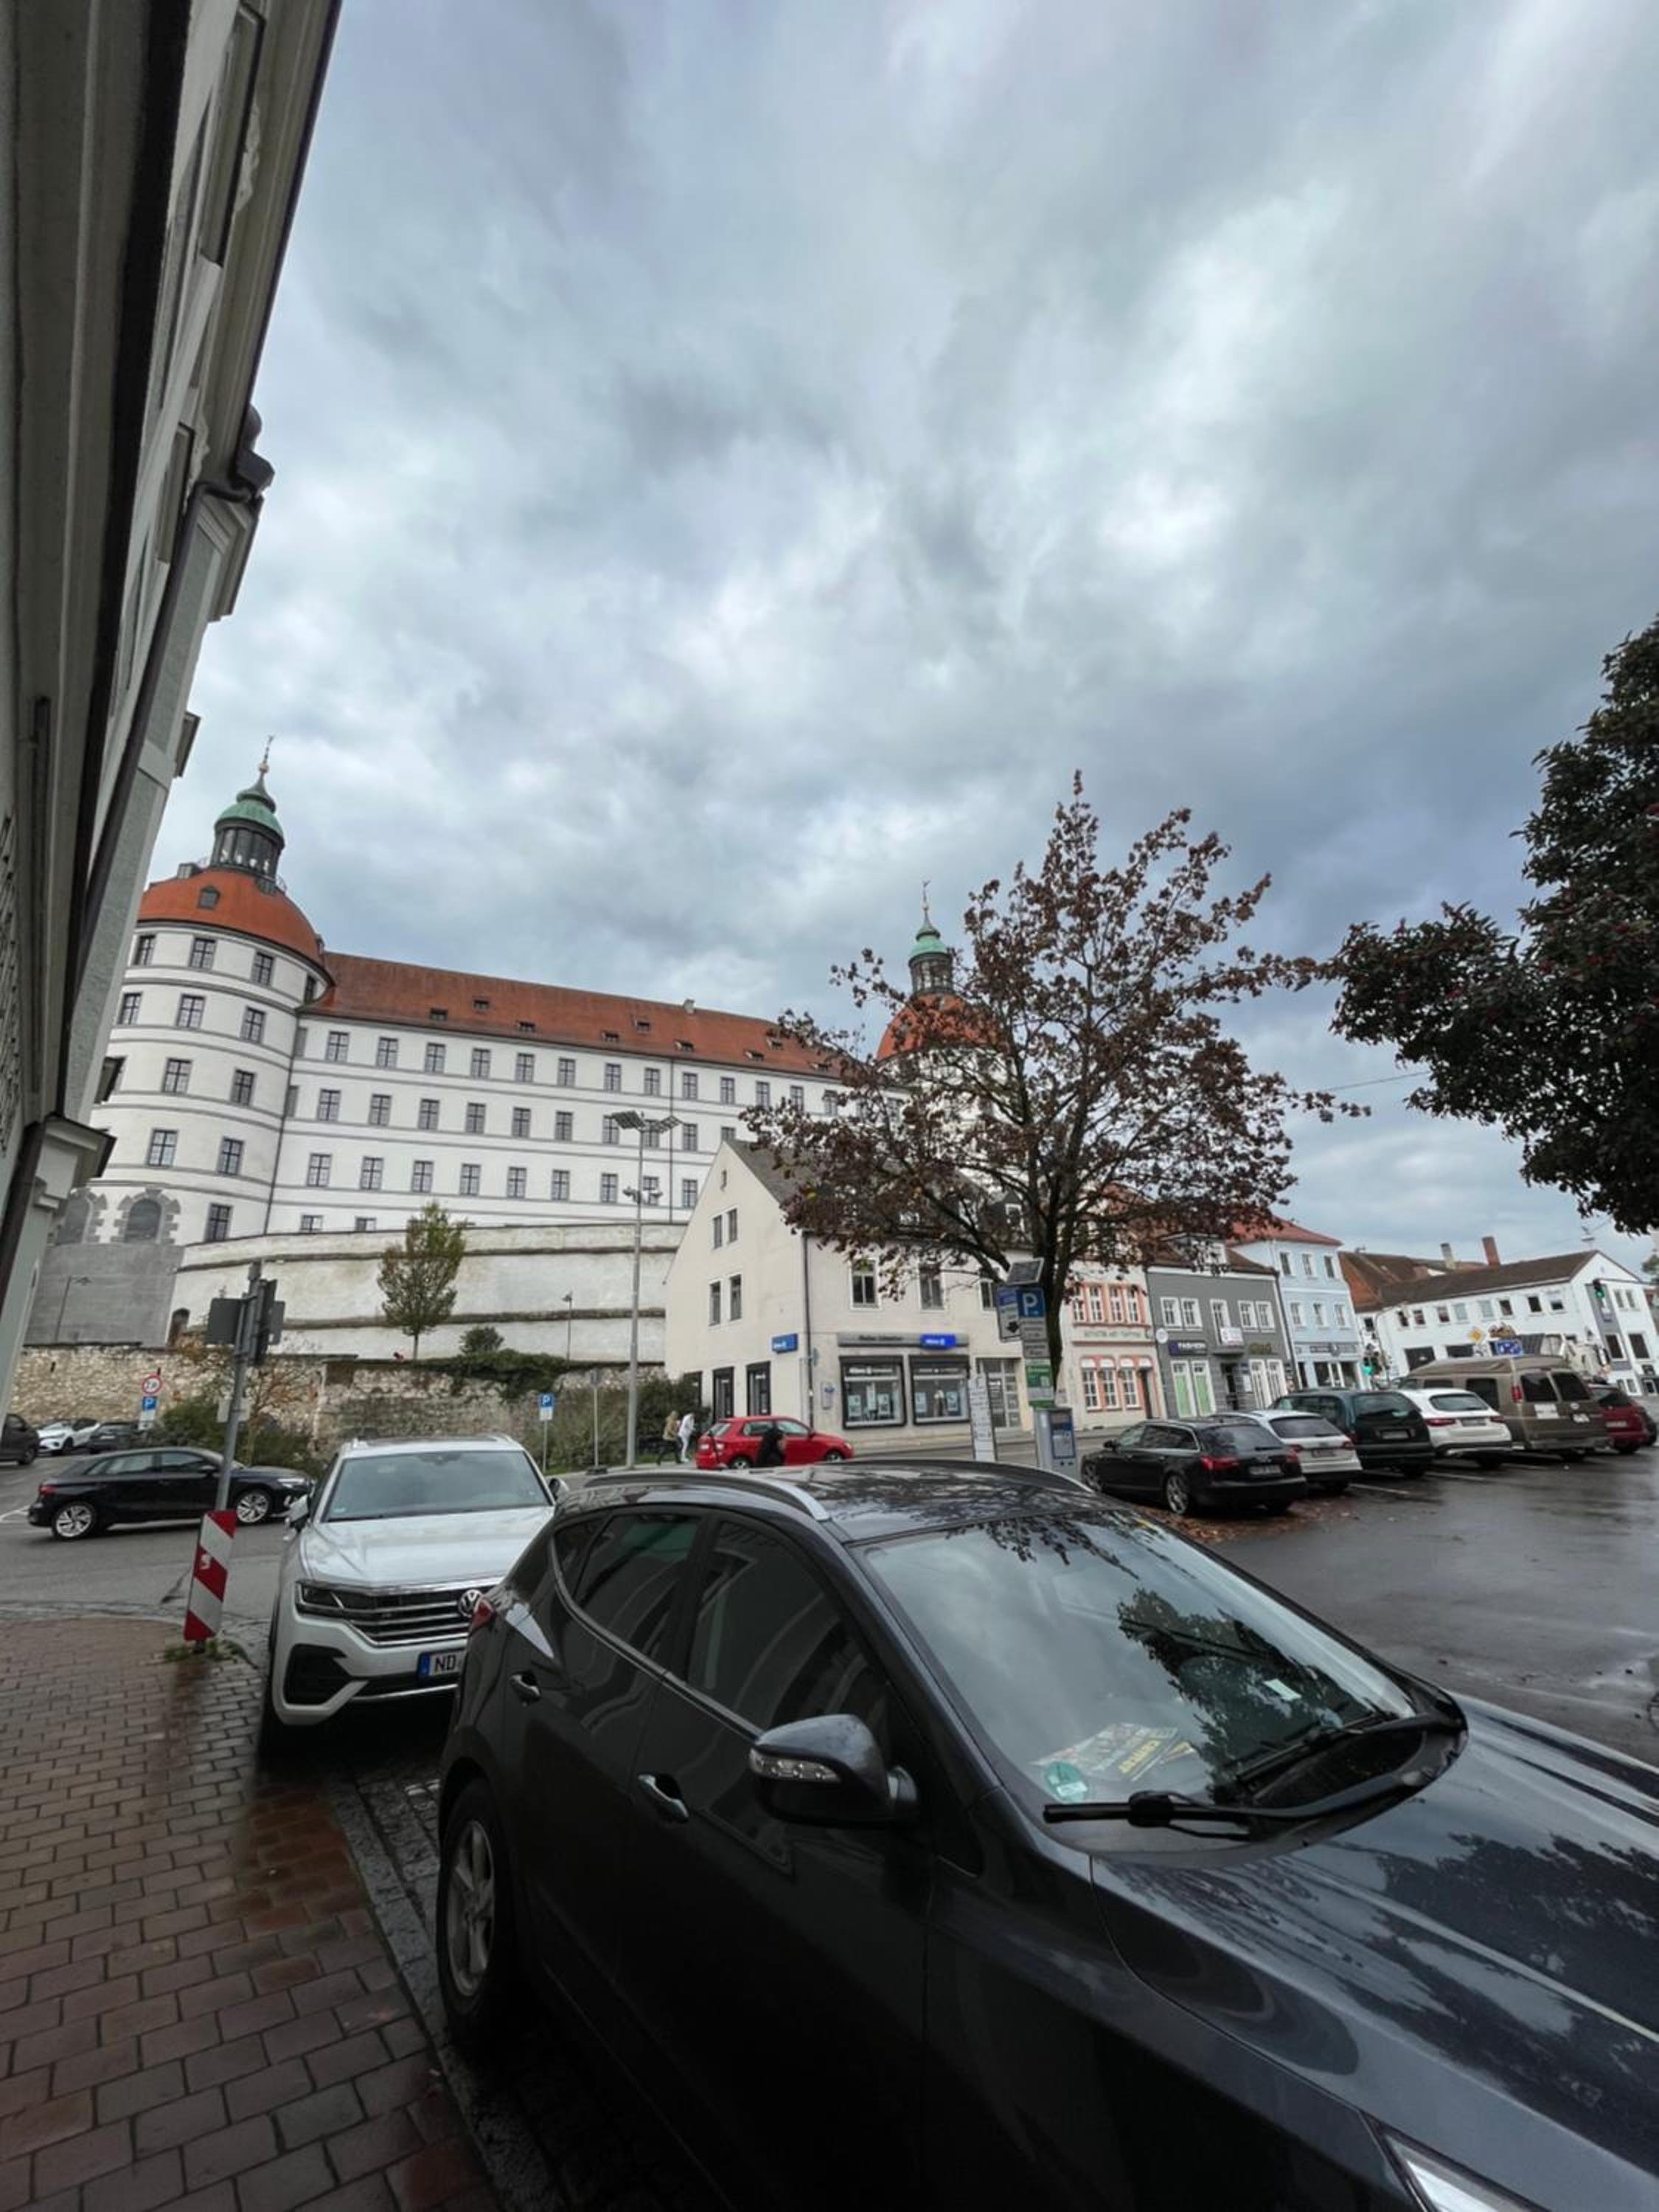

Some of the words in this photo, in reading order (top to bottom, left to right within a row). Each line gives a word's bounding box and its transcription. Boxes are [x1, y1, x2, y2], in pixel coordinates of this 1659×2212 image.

[1022, 1292, 1039, 1316] P
[145, 1397, 154, 1409] P
[542, 1394, 551, 1407] P
[434, 1654, 456, 1672] ND
